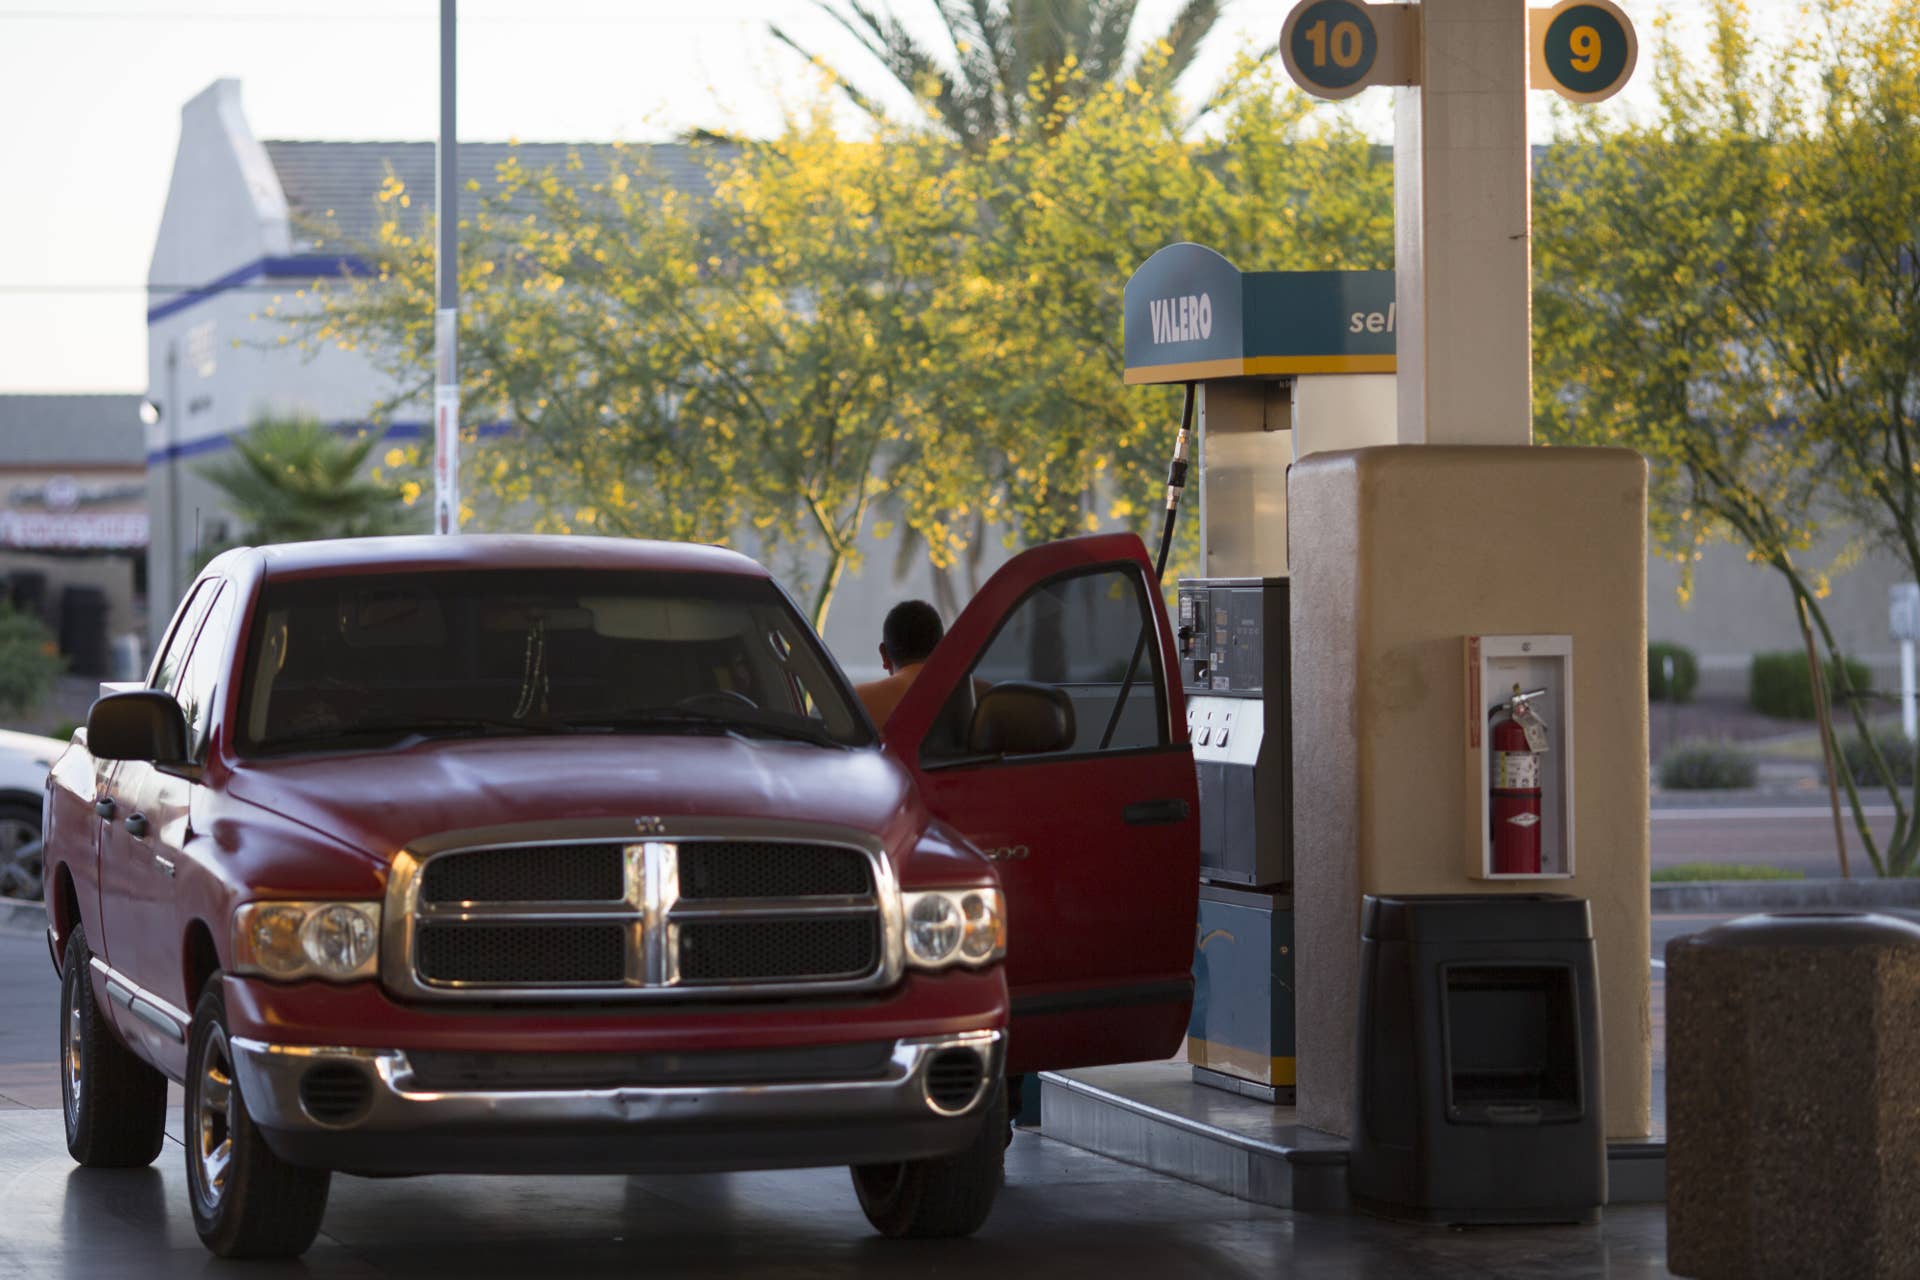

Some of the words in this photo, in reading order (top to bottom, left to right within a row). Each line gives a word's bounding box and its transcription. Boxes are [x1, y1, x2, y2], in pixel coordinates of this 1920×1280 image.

[1305, 19, 1363, 68] 10
[1569, 25, 1602, 73] 9
[1150, 292, 1213, 345] VALERO
